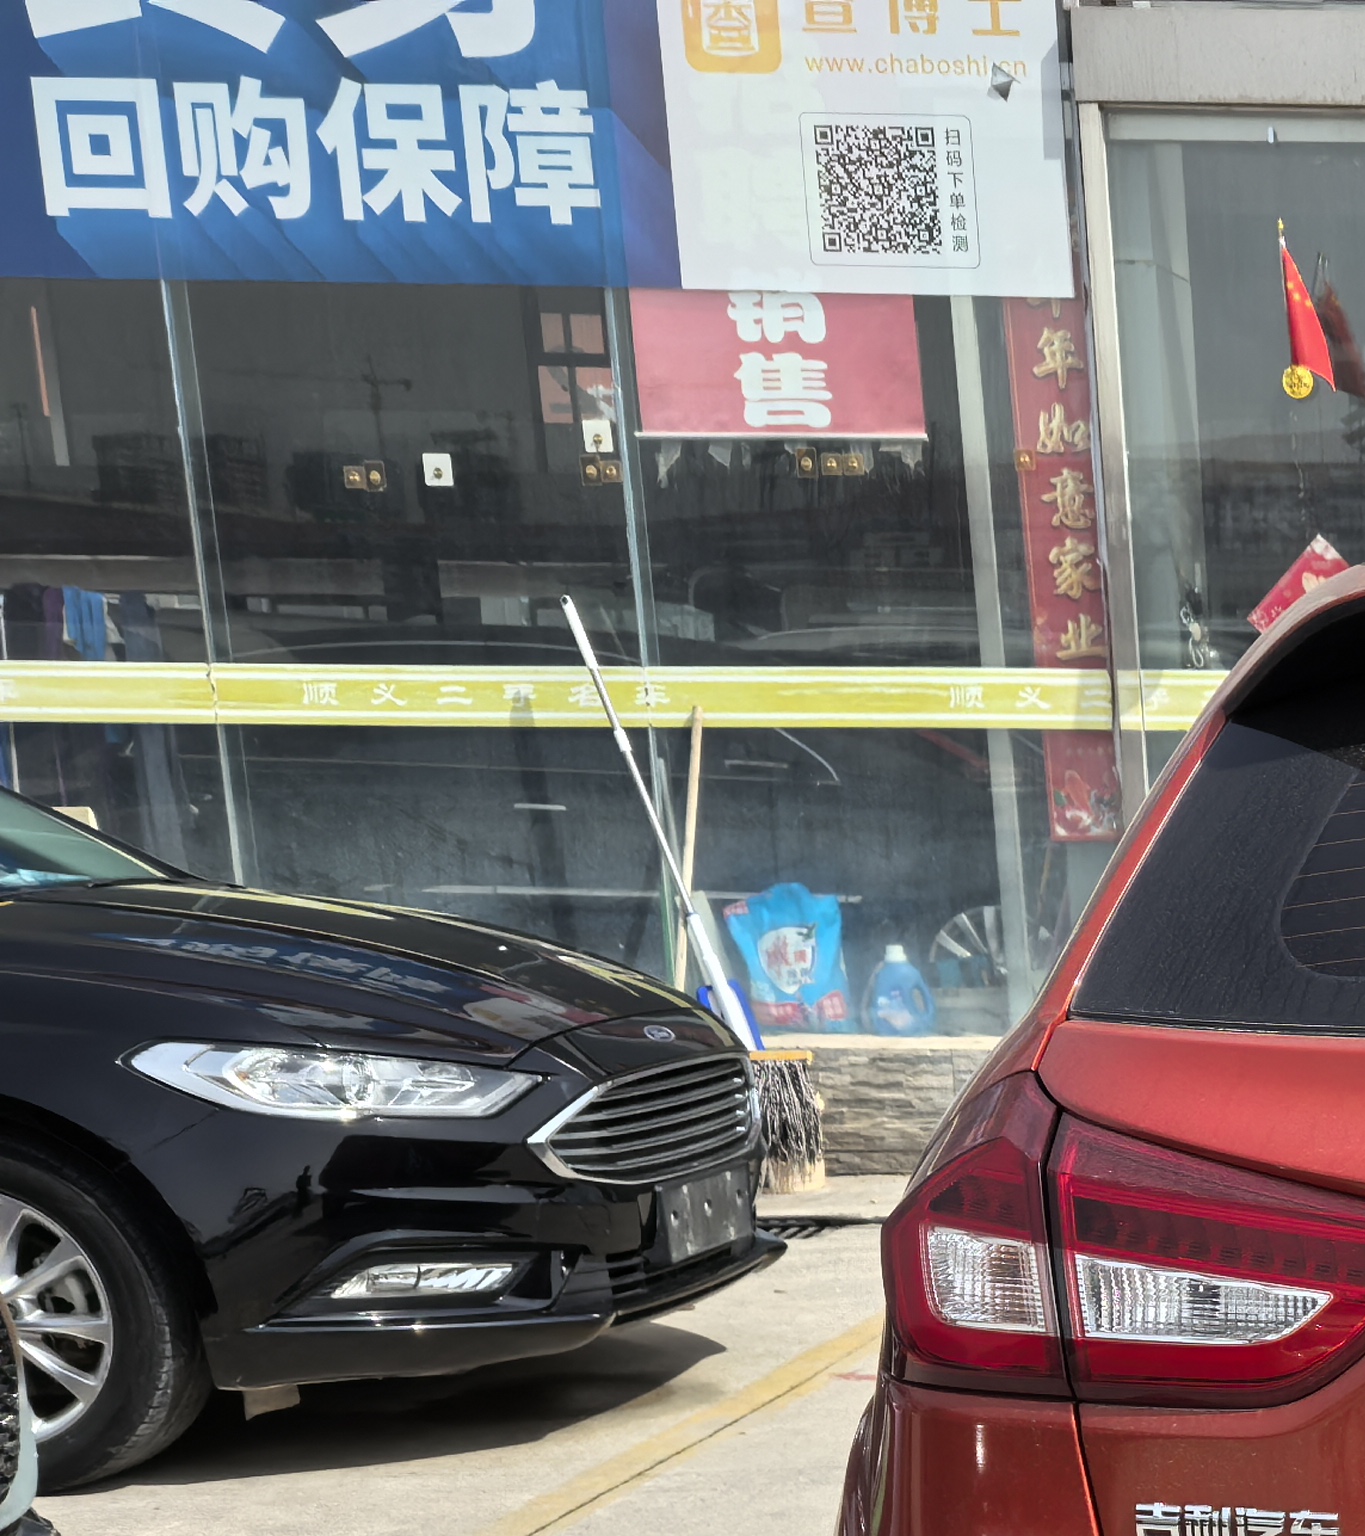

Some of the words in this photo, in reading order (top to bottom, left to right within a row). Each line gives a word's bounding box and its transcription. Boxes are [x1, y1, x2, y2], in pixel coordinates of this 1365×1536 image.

[804, 53, 1028, 79] www.chaboshicn
[29, 75, 602, 225] 回购保障
[944, 127, 969, 253] 扫码下单检测
[1026, 297, 1106, 662] 年如意家业
